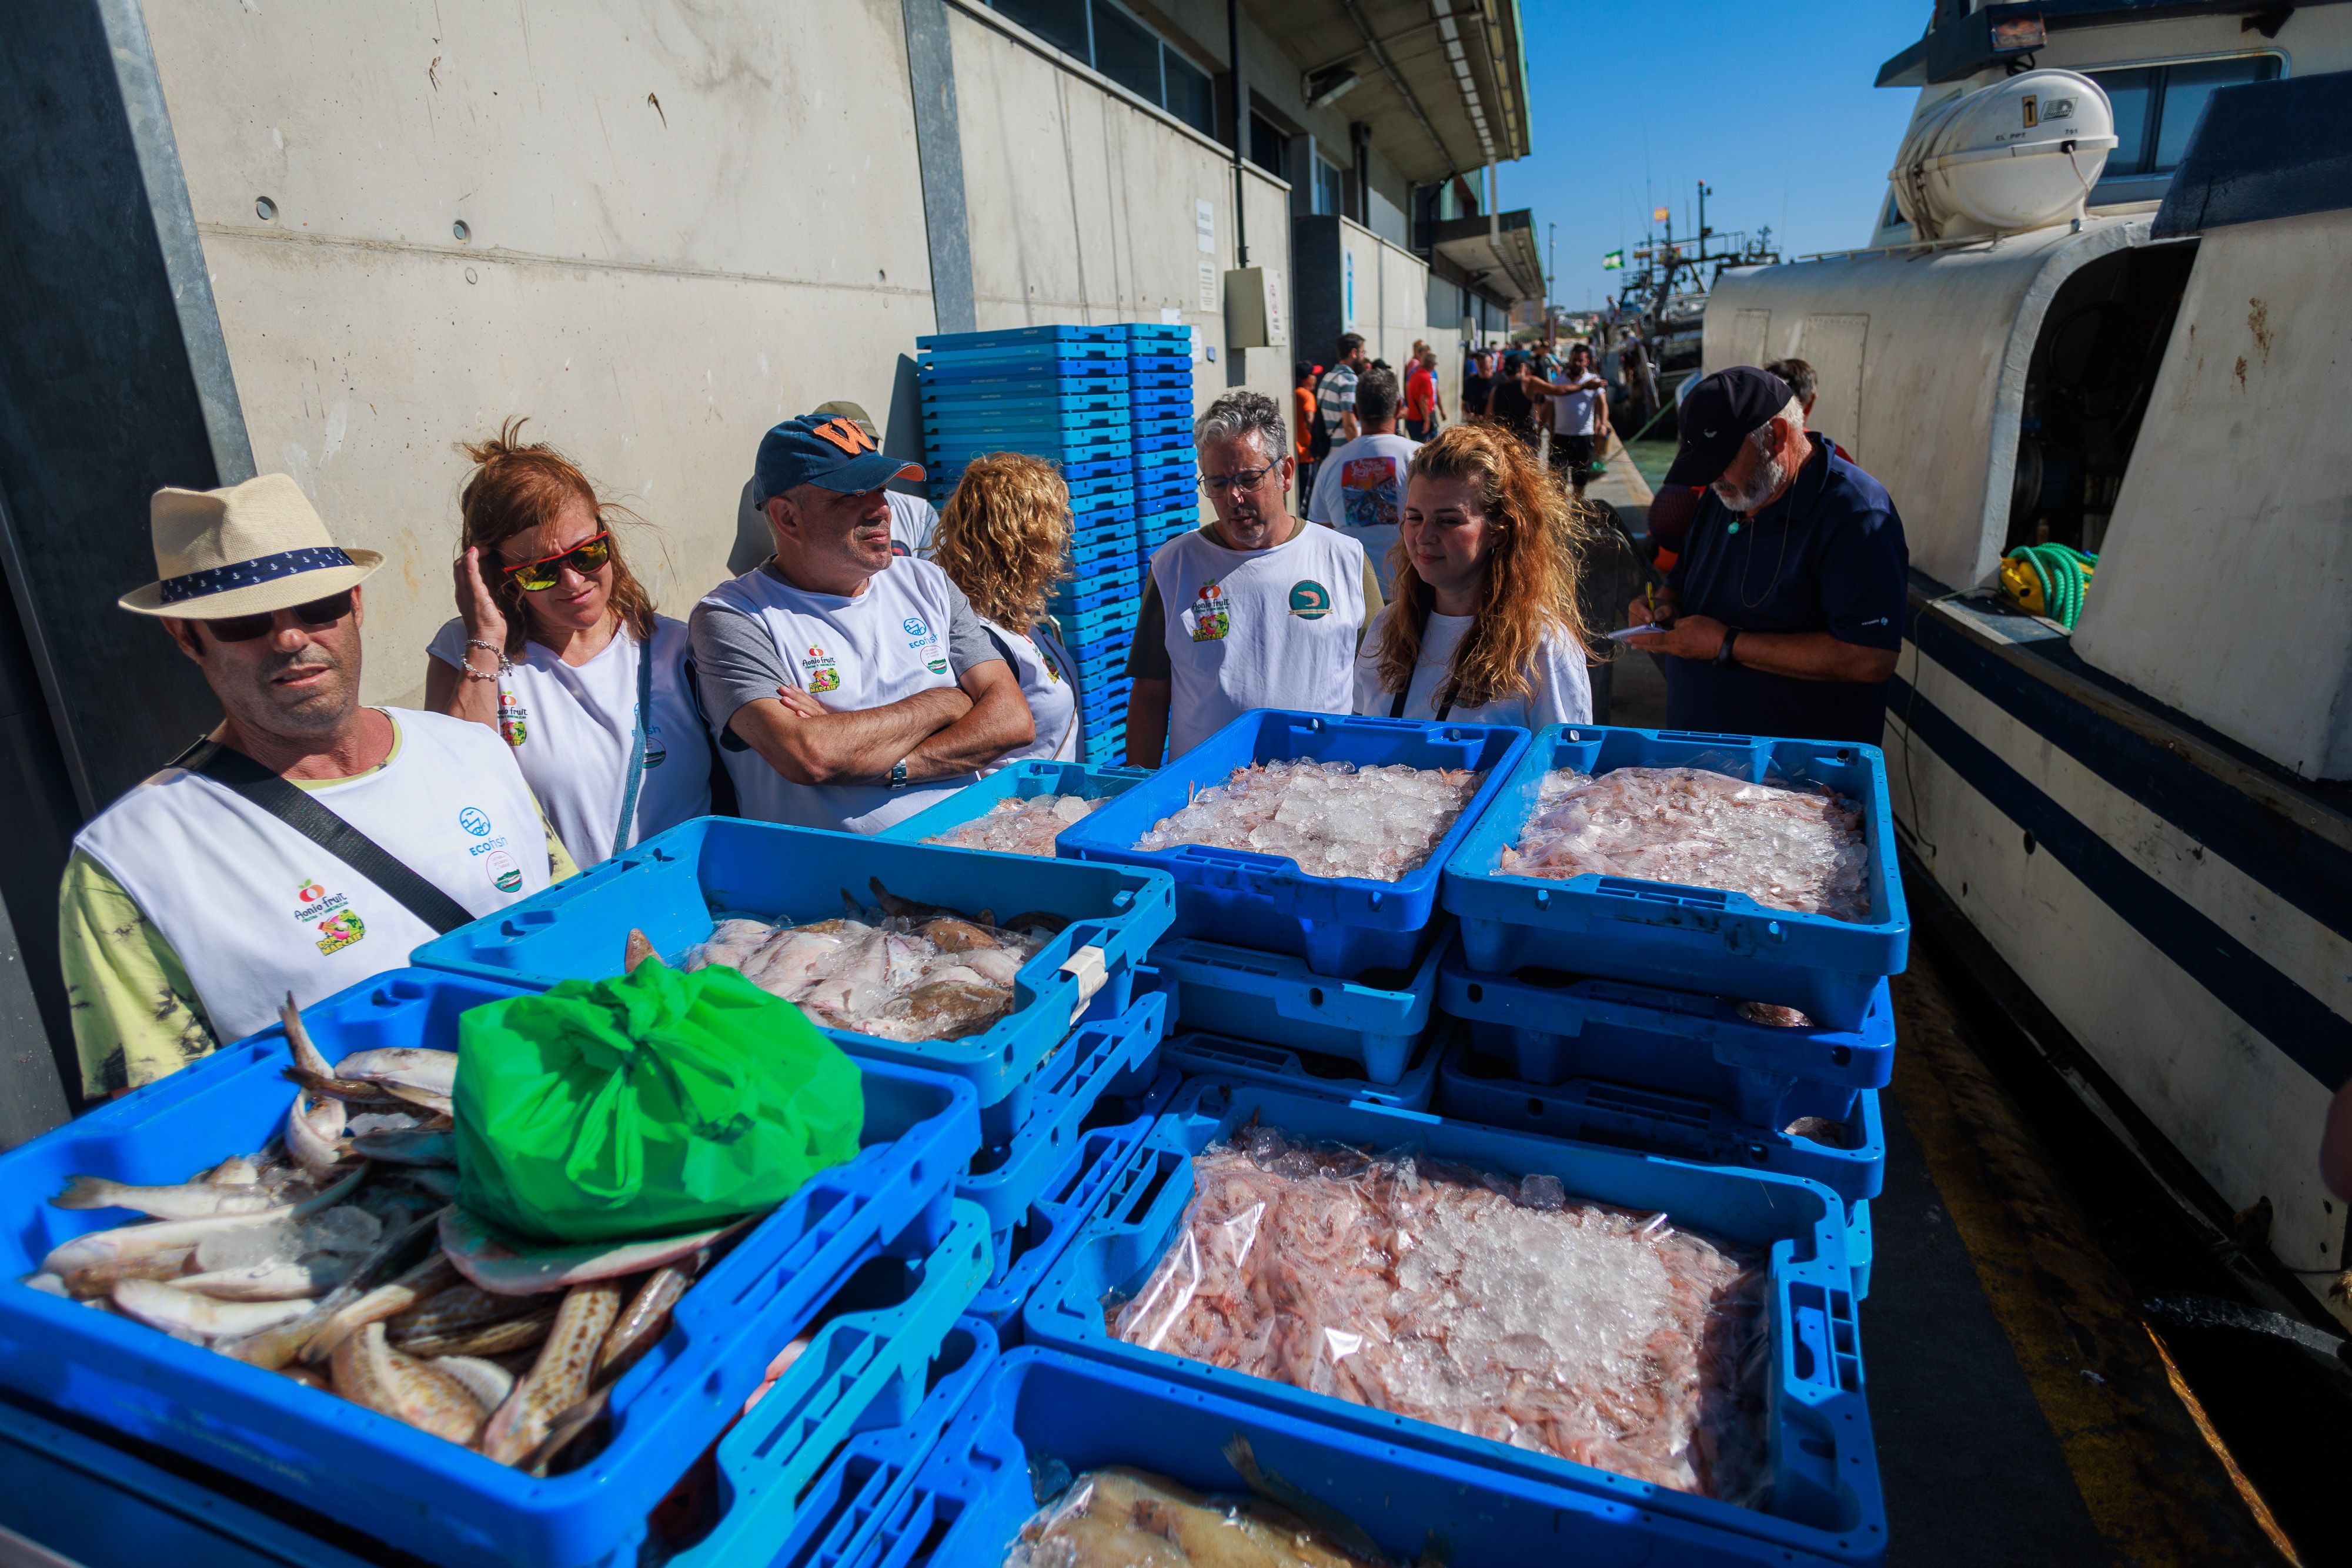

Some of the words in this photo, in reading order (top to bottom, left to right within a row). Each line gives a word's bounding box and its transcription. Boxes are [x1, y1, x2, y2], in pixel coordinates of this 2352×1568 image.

[1192, 601, 1211, 610] Aonio
[1212, 599, 1230, 607] fruit
[908, 633, 940, 648] ECOfish
[803, 658, 820, 666] Aonio
[497, 707, 508, 715] onio
[510, 707, 528, 715] fruit
[469, 835, 508, 856] ECOfish
[294, 904, 323, 920] Aonio
[322, 893, 347, 907] fruit
[316, 935, 337, 948] DON
